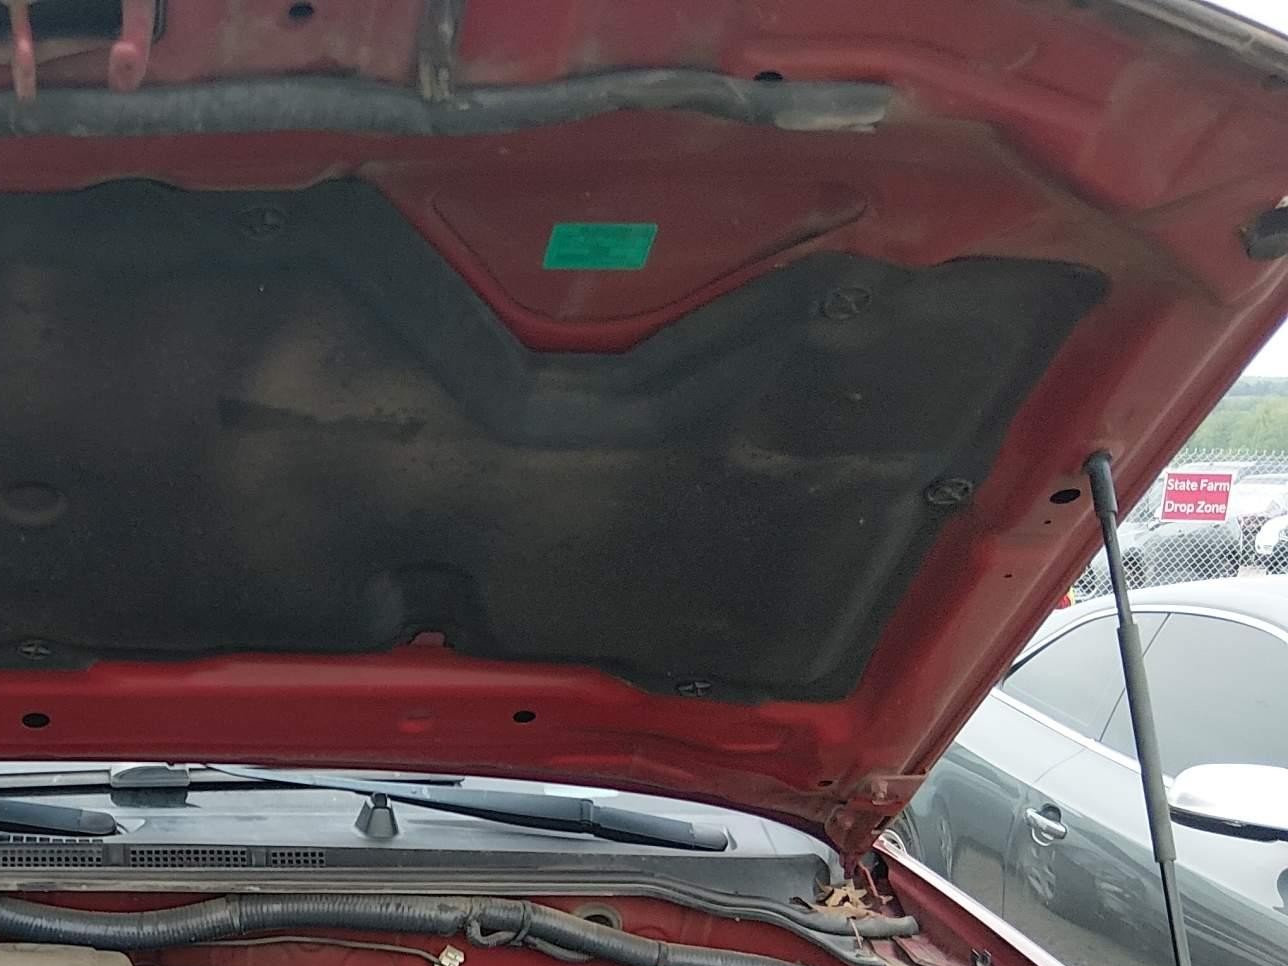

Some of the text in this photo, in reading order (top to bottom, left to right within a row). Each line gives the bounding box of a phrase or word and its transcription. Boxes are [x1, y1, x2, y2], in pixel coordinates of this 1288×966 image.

[1167, 478, 1230, 492] State Farm
[1164, 500, 1227, 515] Drop Zone
